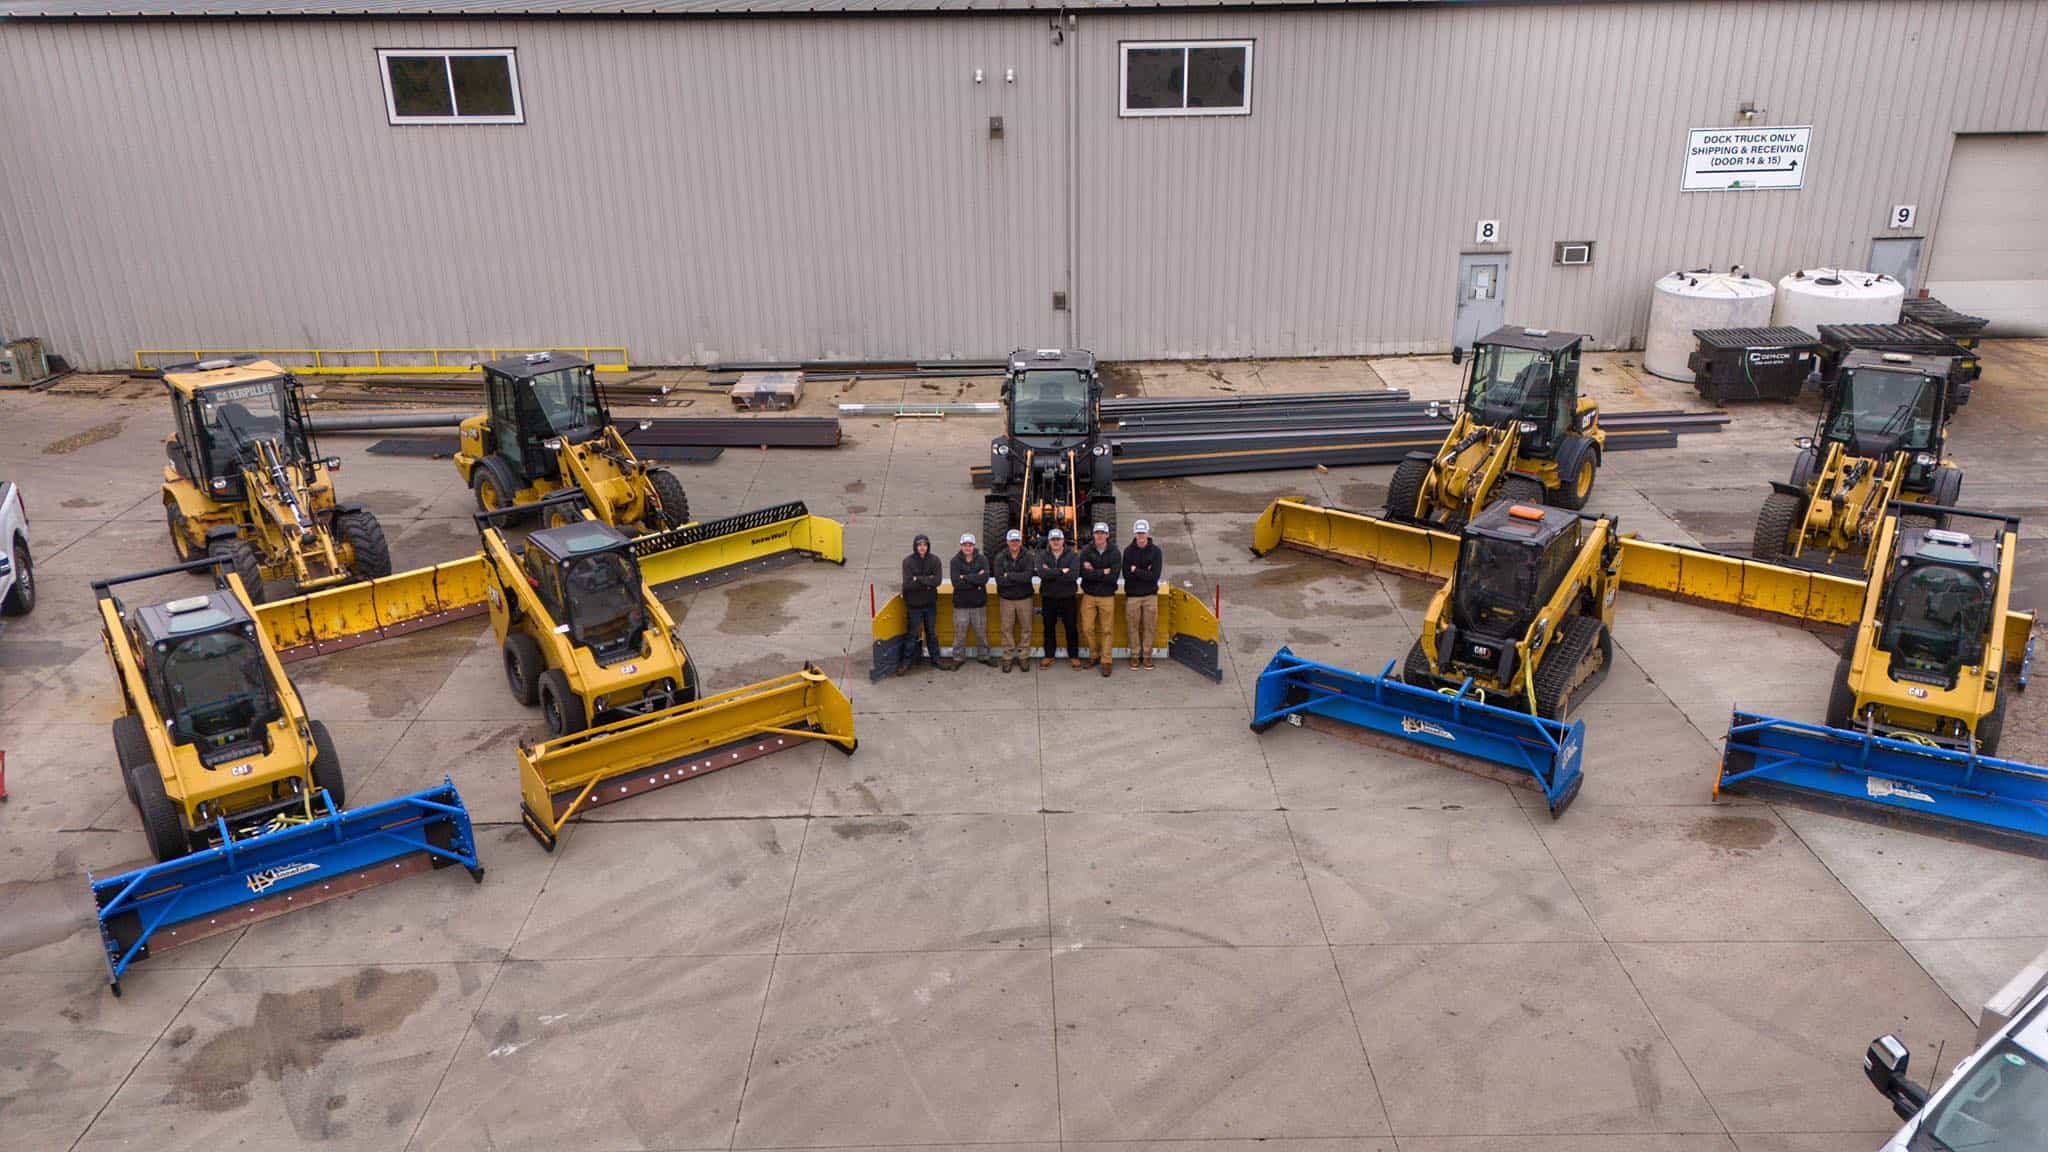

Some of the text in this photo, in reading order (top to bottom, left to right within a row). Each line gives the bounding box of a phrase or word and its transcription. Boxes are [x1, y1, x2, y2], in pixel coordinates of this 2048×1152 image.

[1703, 133, 1796, 144] DOCK TRUCK ONLY
[1691, 146, 1738, 156] SHIPPING
[1750, 144, 1804, 154] RECEIVING
[1710, 156, 1782, 167] (DOOR 14 & 15)
[1898, 208, 1910, 223] 9
[1482, 223, 1494, 238] 8
[216, 383, 275, 401] CATERPILLAR
[751, 530, 788, 545] SnowWolf
[1474, 645, 1487, 657] CAT
[1908, 687, 1924, 697] CAT
[232, 764, 249, 777] CAT
